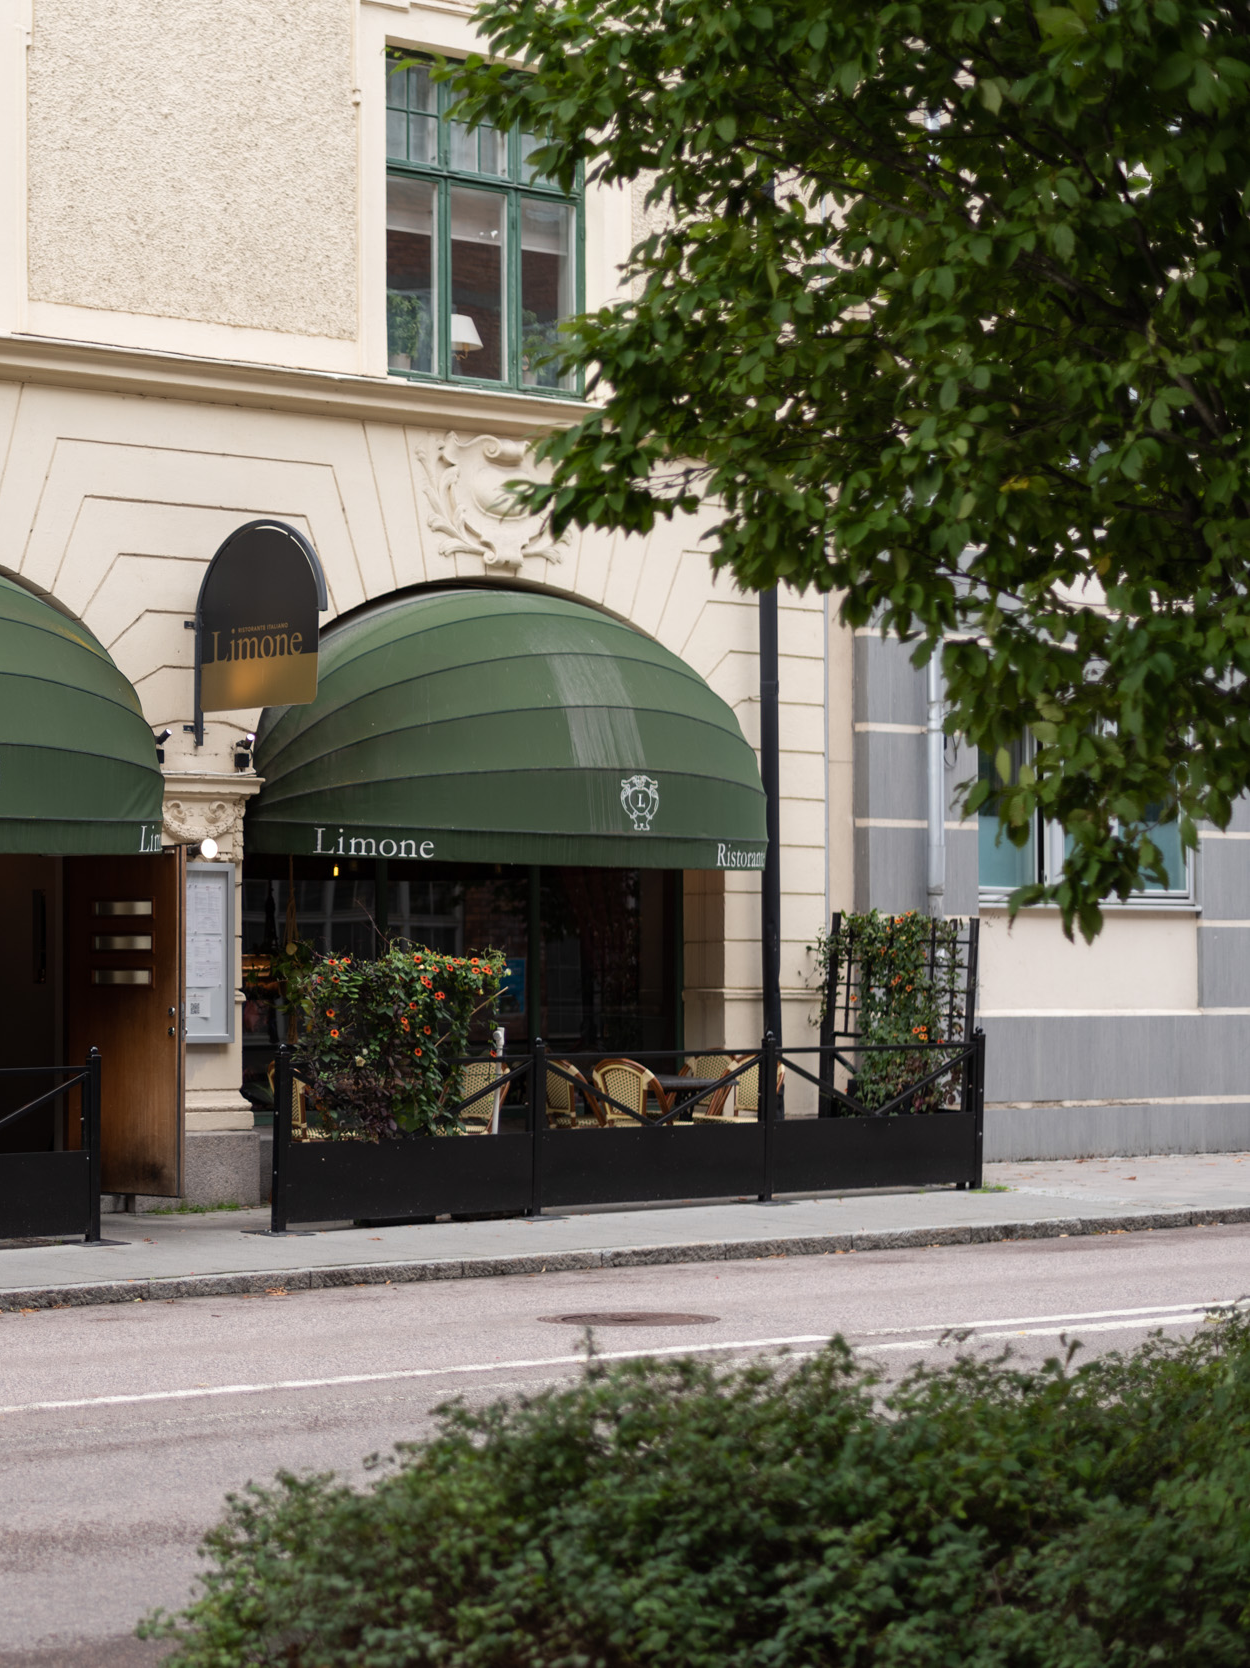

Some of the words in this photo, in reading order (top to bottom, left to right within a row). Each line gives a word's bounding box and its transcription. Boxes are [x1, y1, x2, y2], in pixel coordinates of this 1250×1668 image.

[238, 624, 266, 633] RISTORANTE
[267, 622, 289, 631] ITALIANO
[211, 628, 303, 664] Limone
[637, 793, 646, 808] L
[312, 827, 435, 859] Limone
